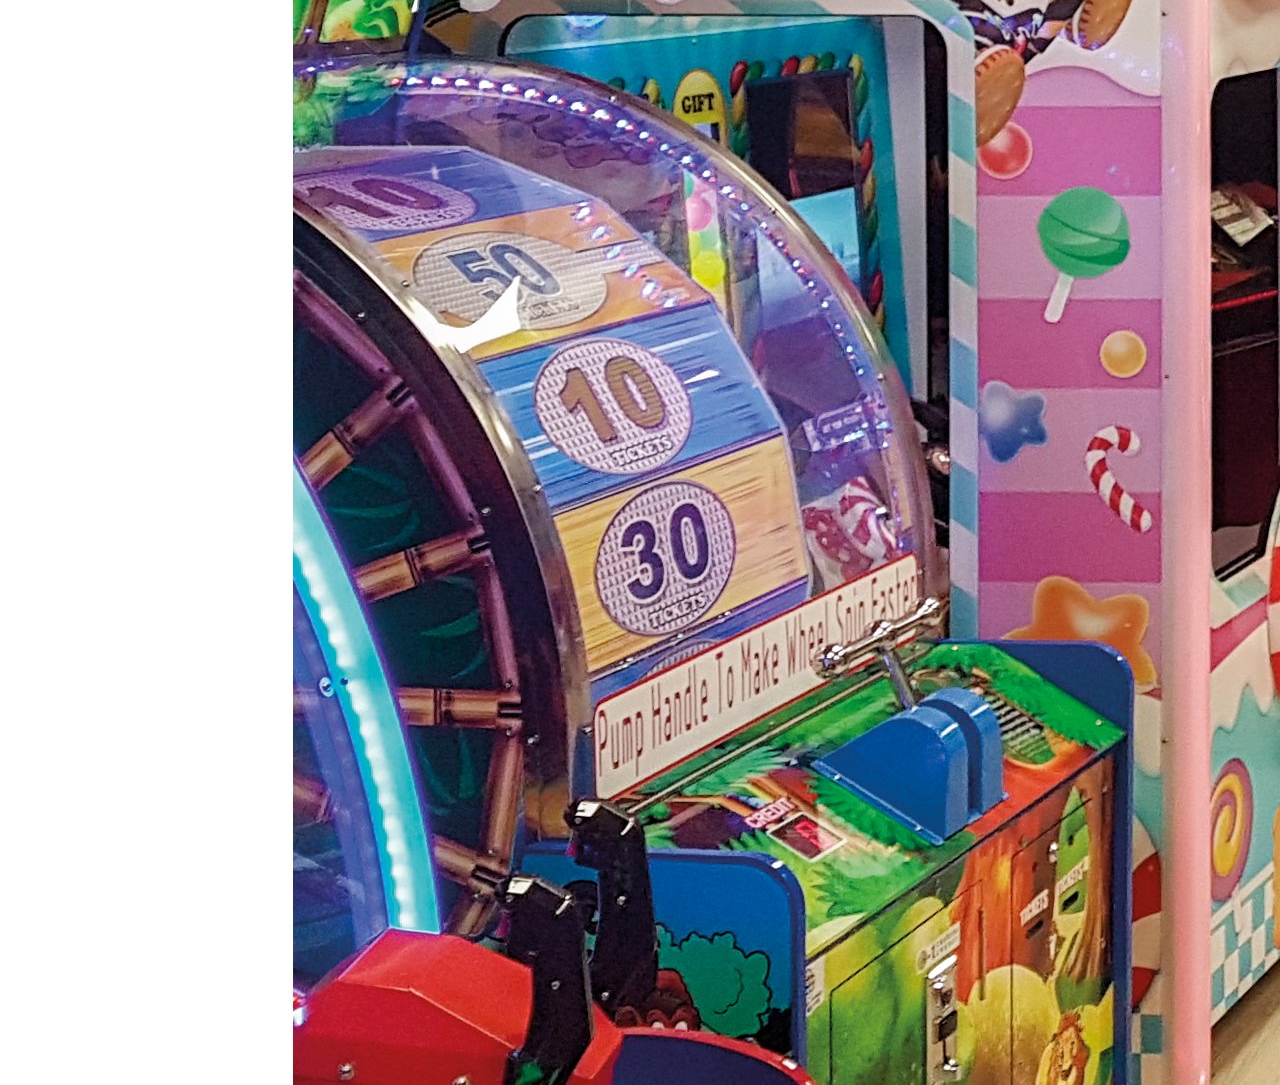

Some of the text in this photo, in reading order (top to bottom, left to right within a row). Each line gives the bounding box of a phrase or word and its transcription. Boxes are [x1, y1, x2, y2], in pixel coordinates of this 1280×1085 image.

[681, 91, 715, 114] GIFT
[446, 242, 552, 304] 50
[559, 354, 667, 443] 10
[611, 435, 674, 467] TICKETS
[619, 500, 711, 603] 30
[650, 590, 708, 630] TICKETS
[598, 566, 917, 777] Pump Handle To Make Wheel Spin Faster
[744, 797, 797, 828] CREDIT
